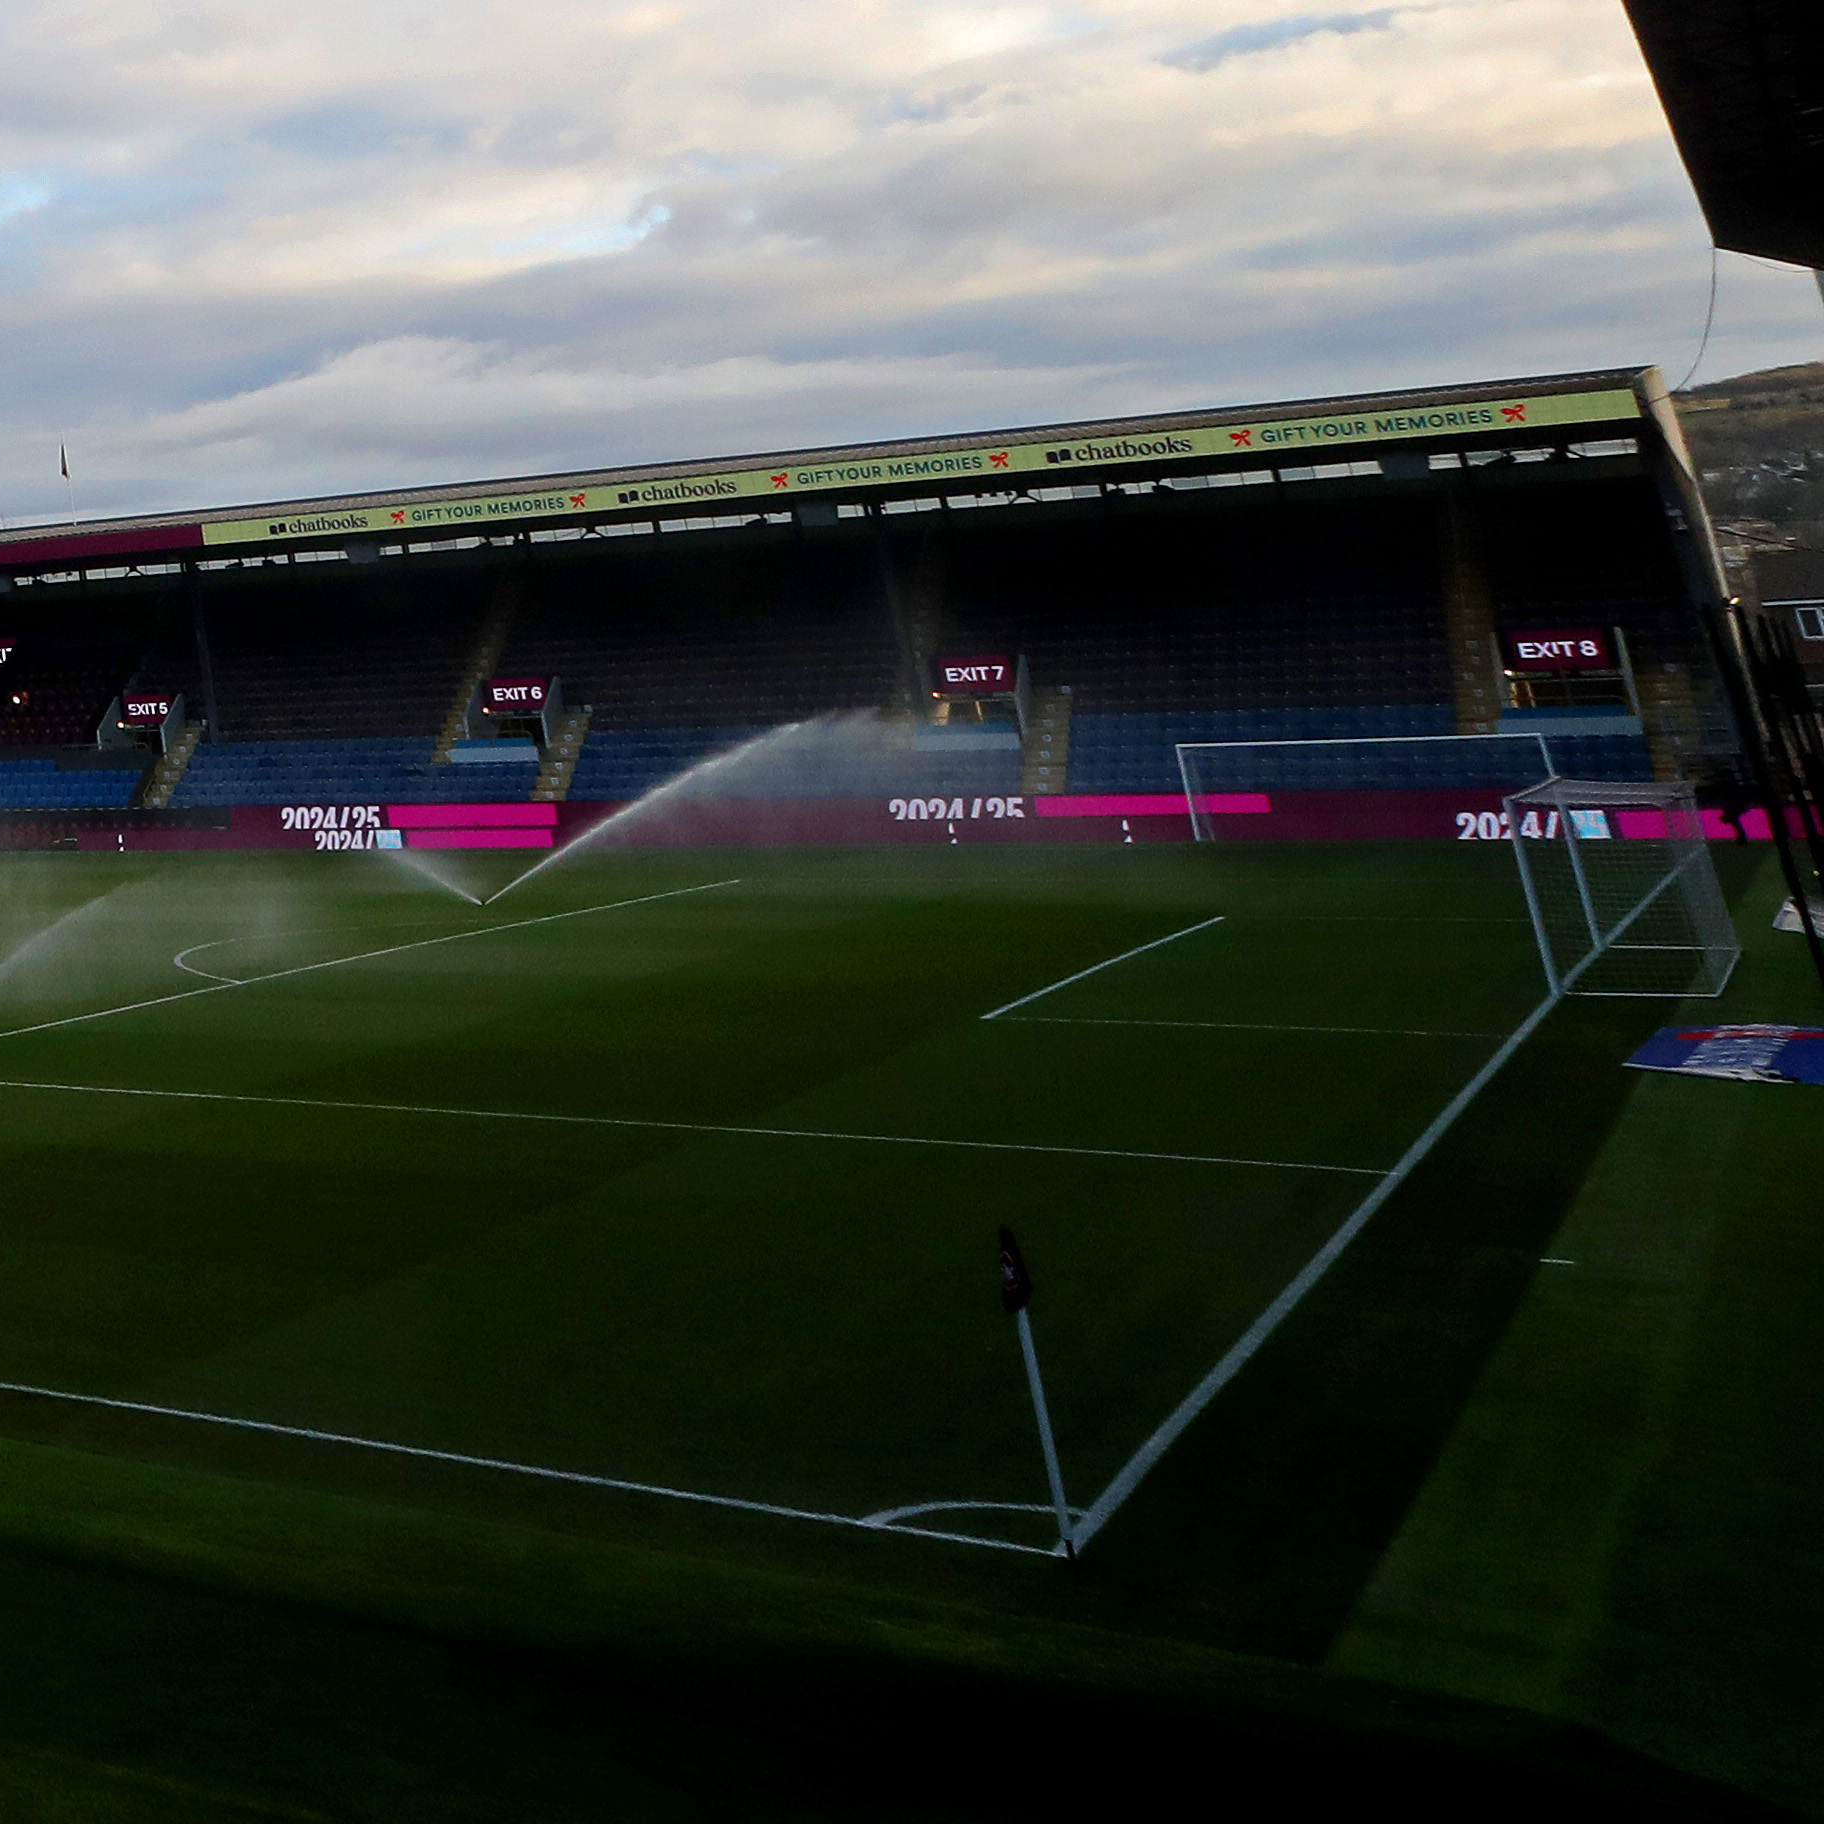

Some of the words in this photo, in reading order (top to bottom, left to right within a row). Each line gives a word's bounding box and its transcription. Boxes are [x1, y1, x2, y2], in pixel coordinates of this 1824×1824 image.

[1261, 427, 1306, 443] GIFT
[1310, 421, 1367, 440] YOUR
[1375, 409, 1492, 433] MEMORIES
[1076, 435, 1192, 462] chatbooks
[797, 470, 836, 485] GIFT
[836, 465, 882, 482] YOUR
[887, 456, 982, 478] MEMORIES
[642, 480, 737, 503] chatbooks
[412, 508, 442, 522] GIFT
[443, 505, 483, 520] YOUR
[487, 496, 565, 516] MEMORIES
[289, 514, 369, 536] chatbooks
[1516, 640, 1576, 659] EXIT
[1578, 639, 1599, 657] 8
[944, 666, 990, 683] EXIT
[991, 665, 1004, 680] 7
[492, 686, 528, 701] EXIT
[530, 685, 543, 699] 6
[127, 702, 157, 716] EXIT
[159, 702, 169, 715] 5
[280, 805, 380, 830] 2024/25
